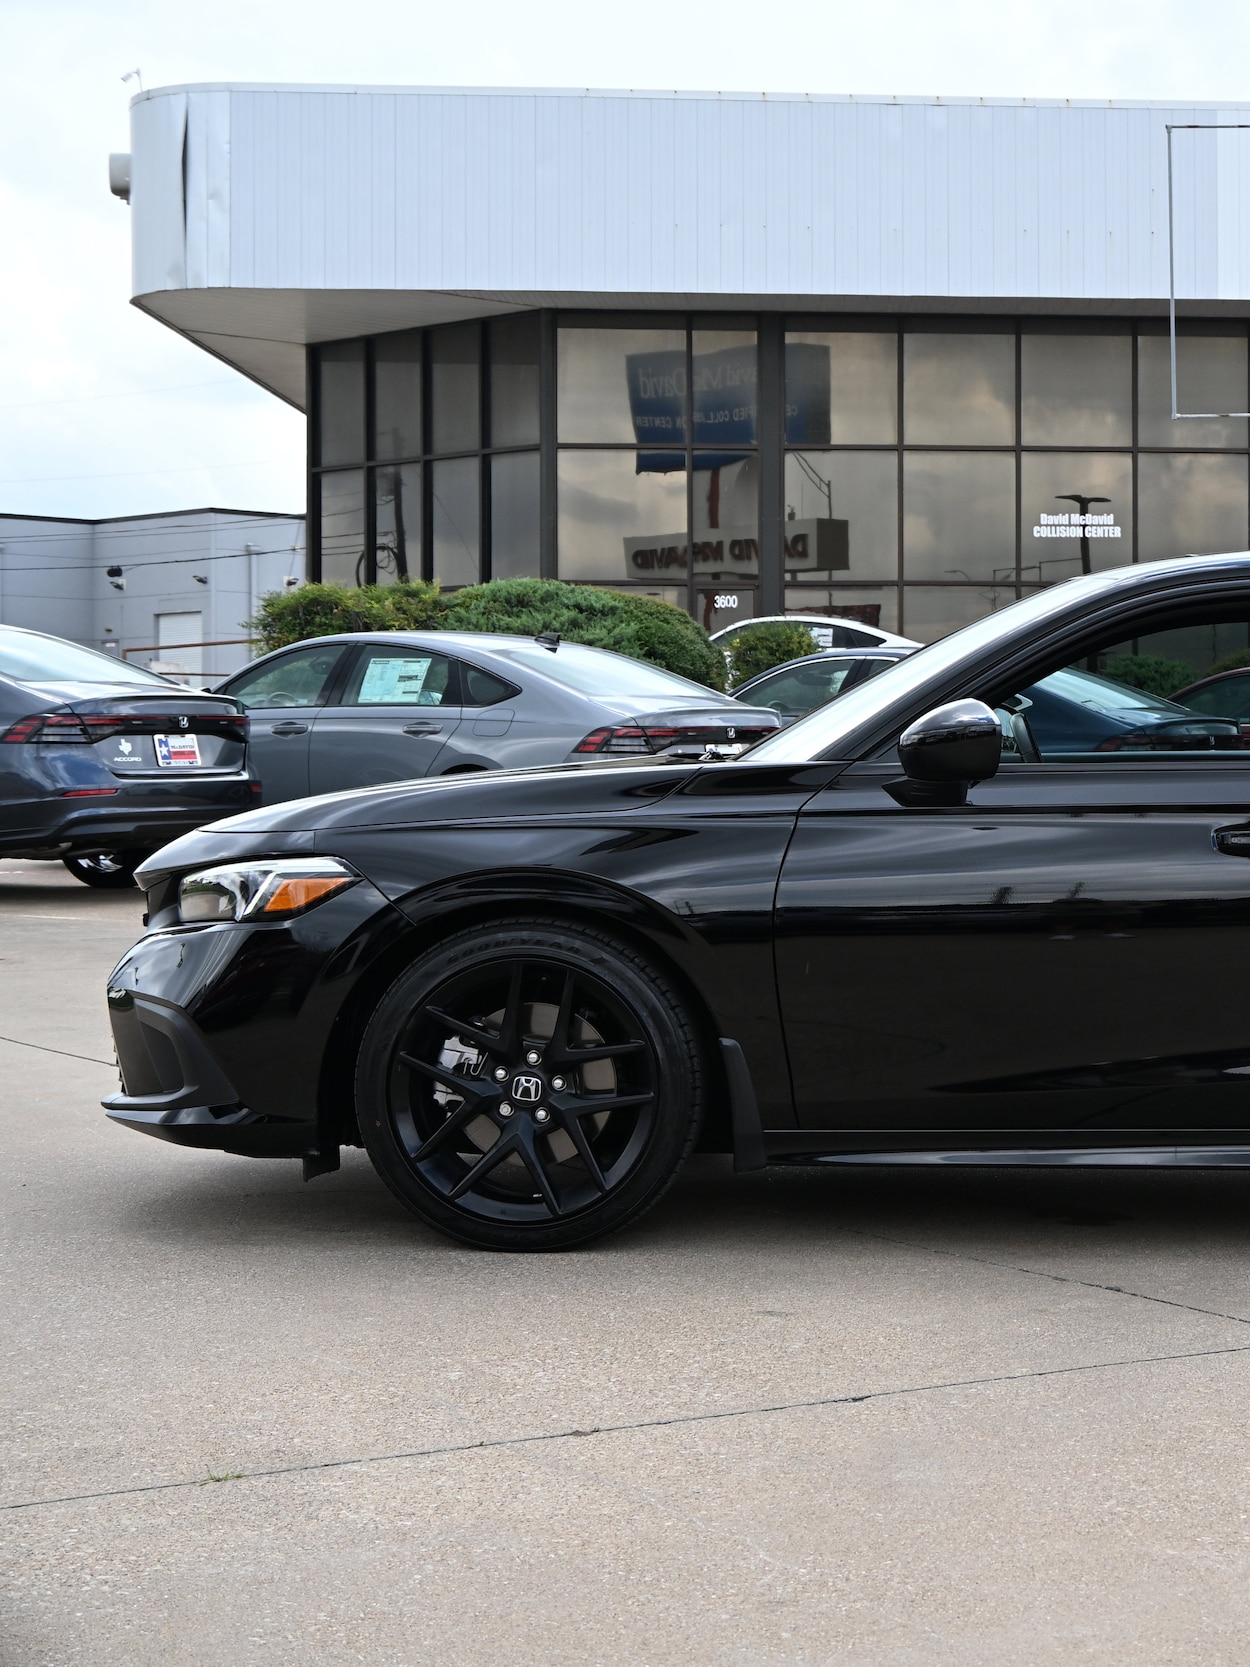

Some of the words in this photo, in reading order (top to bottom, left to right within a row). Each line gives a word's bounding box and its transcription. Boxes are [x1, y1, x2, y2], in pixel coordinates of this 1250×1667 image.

[1040, 513, 1069, 525] David
[1070, 513, 1114, 525] McDavid
[1033, 526, 1083, 537] COLLISION
[1084, 526, 1121, 537] CENTER
[714, 595, 737, 608] 3600
